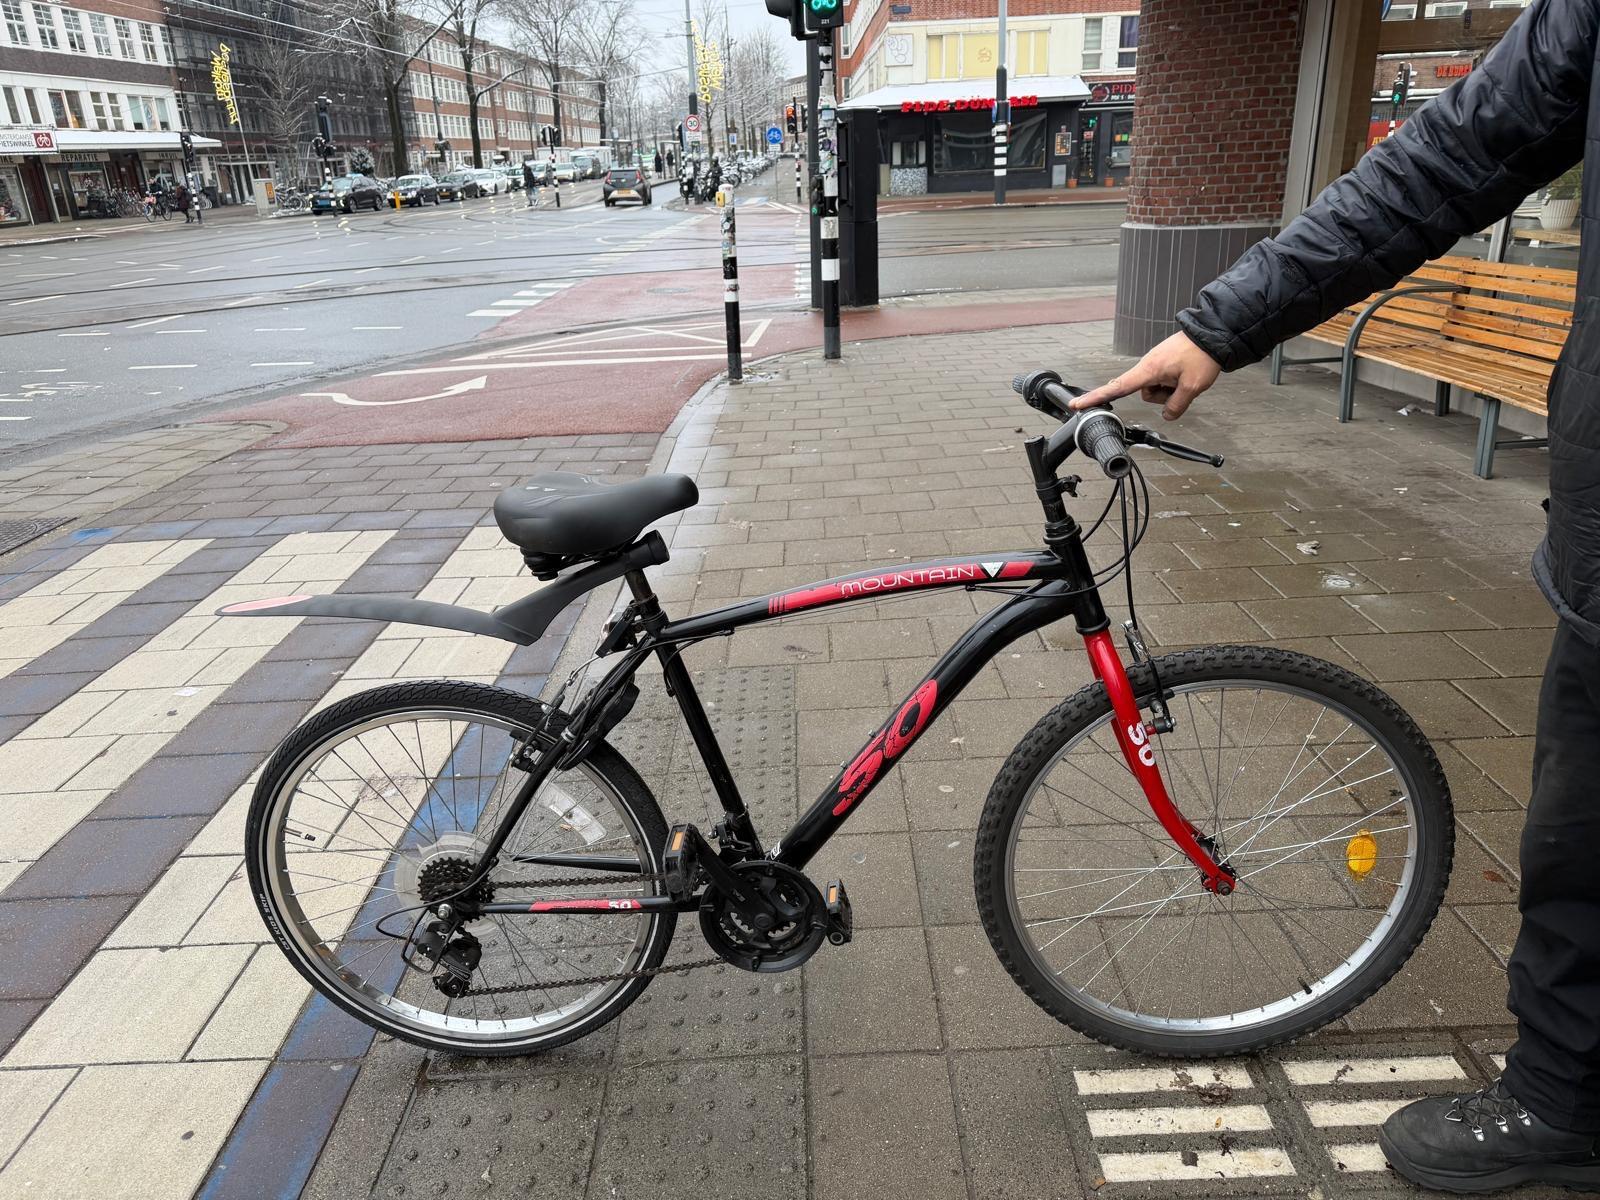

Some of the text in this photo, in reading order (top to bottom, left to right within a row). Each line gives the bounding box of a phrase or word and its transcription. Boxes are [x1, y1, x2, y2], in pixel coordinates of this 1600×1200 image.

[901, 100, 950, 112] PIDE
[841, 565, 975, 596] MOUNTAIN
[259, 893, 271, 914] SKIP
[268, 915, 281, 935] KIDS
